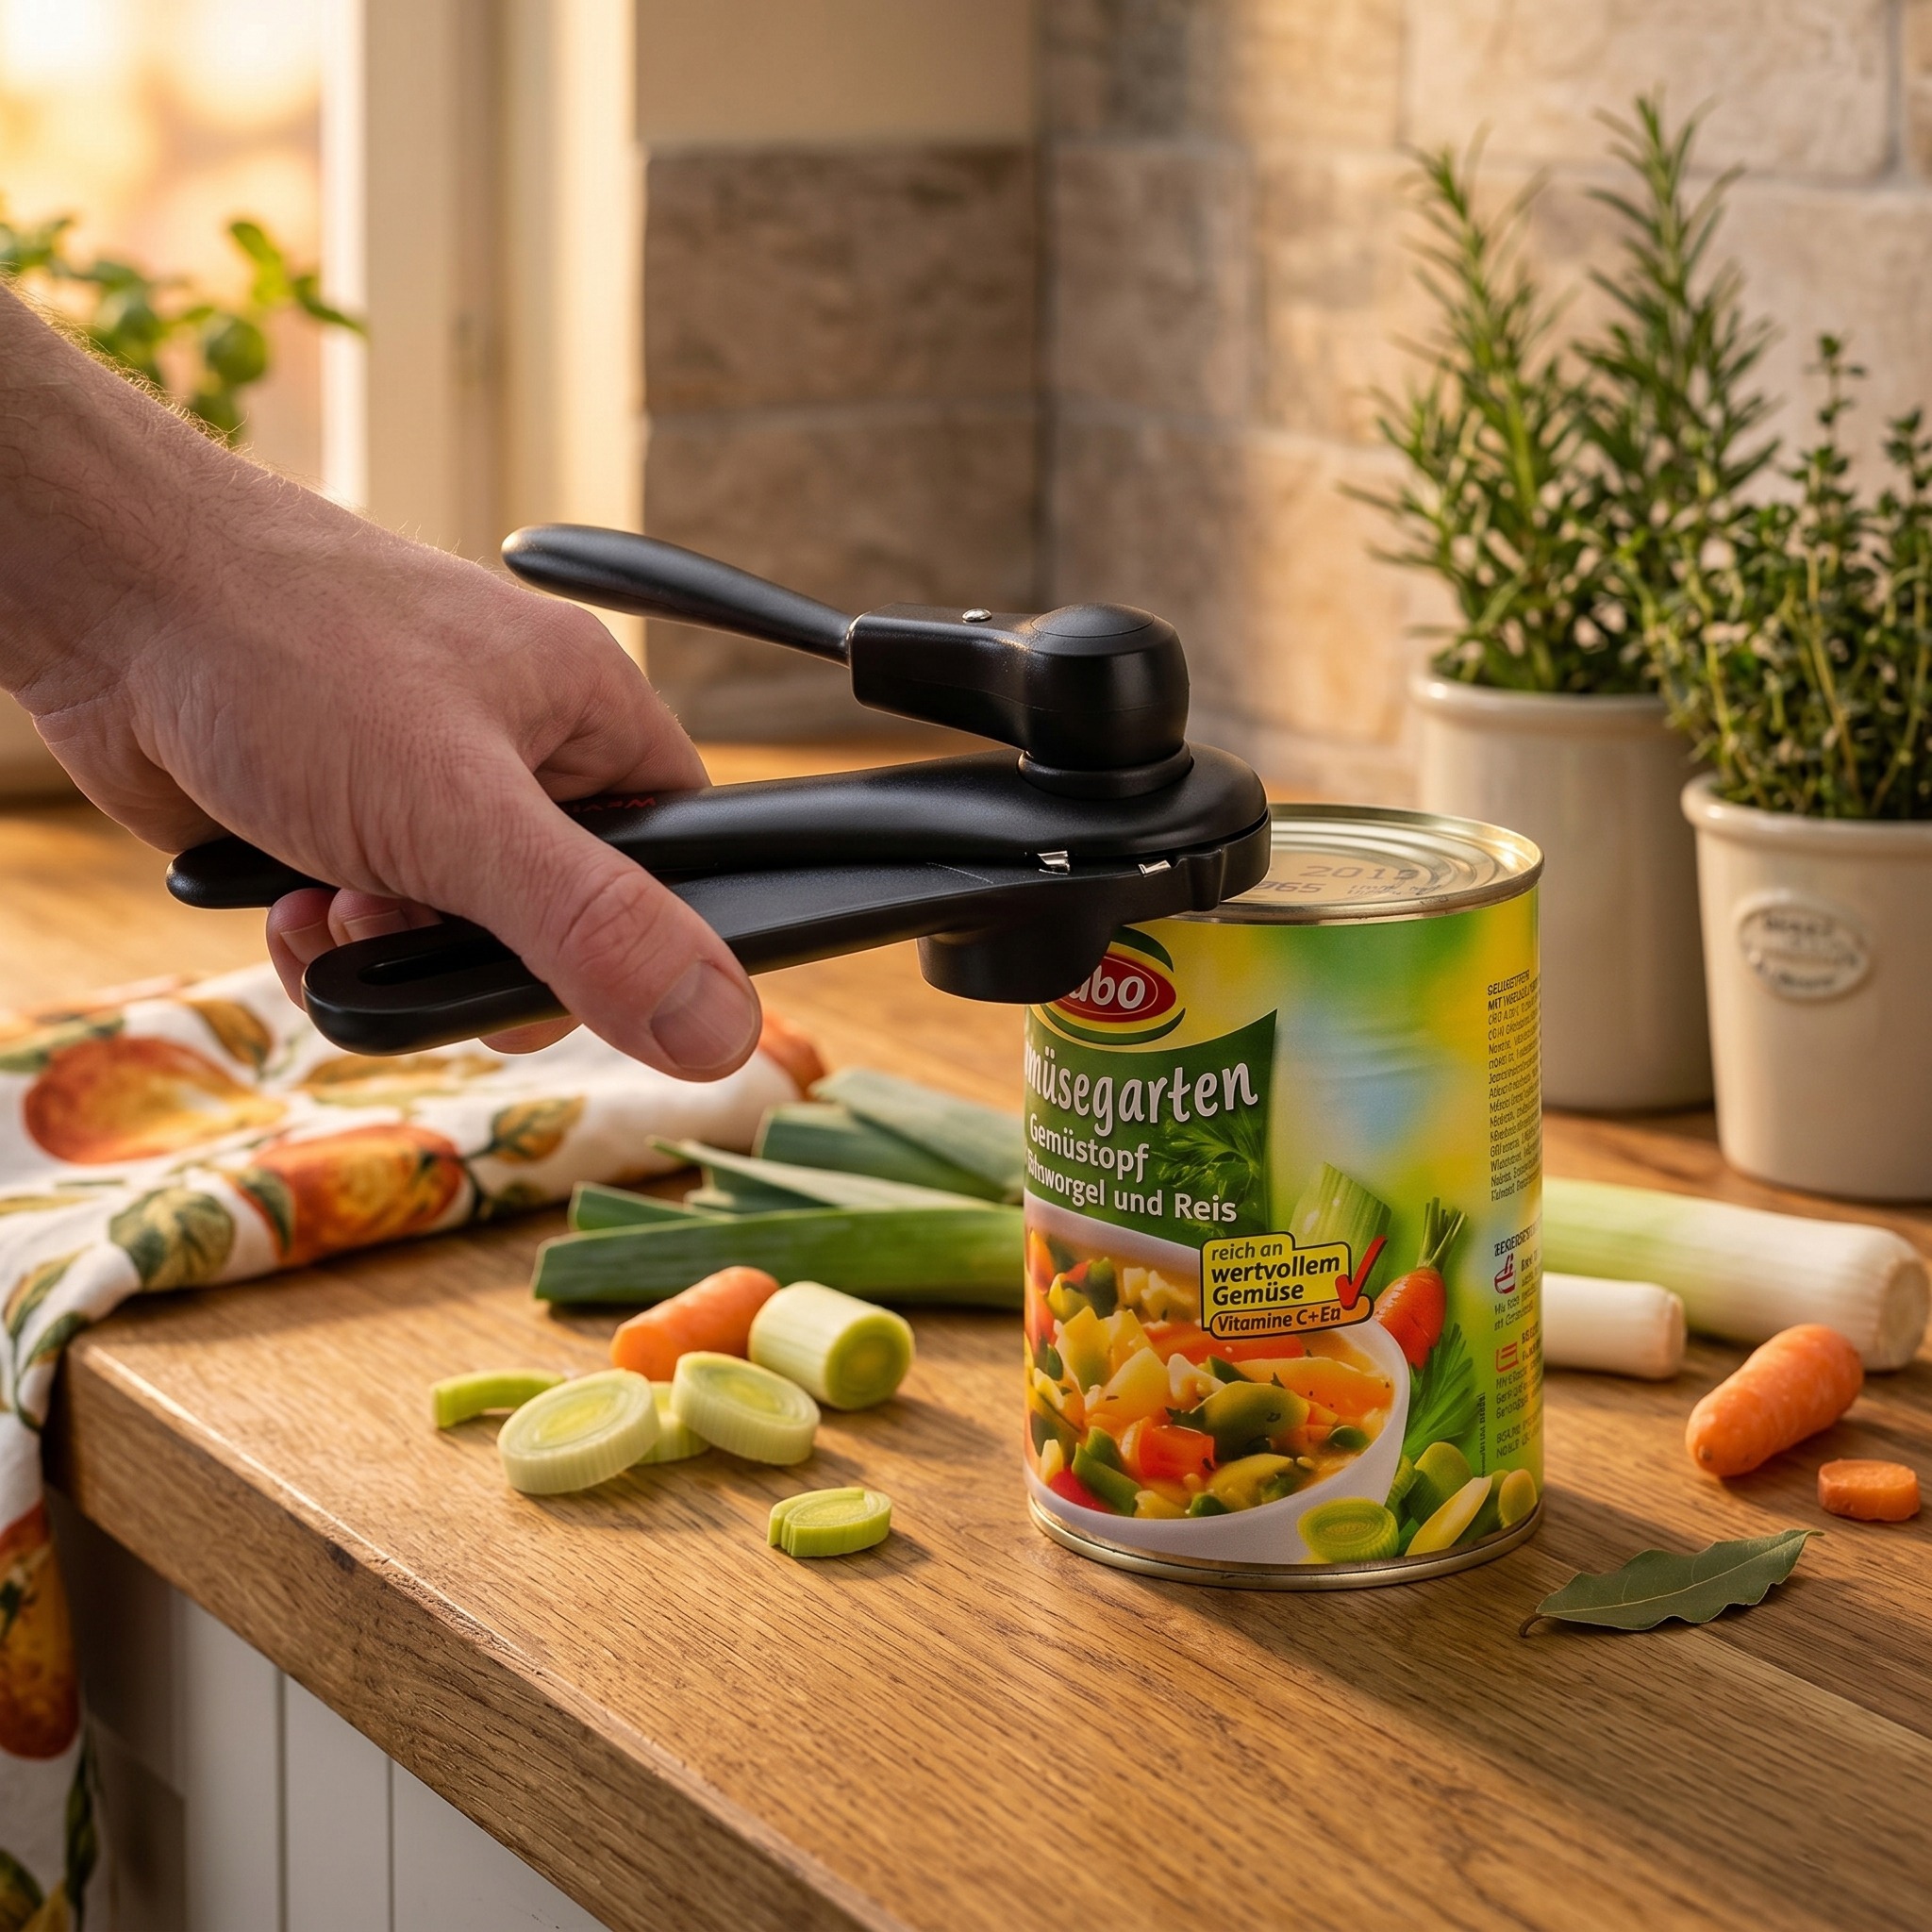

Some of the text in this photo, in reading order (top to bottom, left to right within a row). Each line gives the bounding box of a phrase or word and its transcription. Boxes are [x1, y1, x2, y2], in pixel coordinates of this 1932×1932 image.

[1030, 1112, 1150, 1183] Gemüstopf
[1114, 1190, 1163, 1216] und
[1174, 1193, 1238, 1223] Reis
[1211, 1241, 1283, 1261] reich an
[1211, 1255, 1341, 1283] wertvollem
[1212, 1281, 1305, 1306] Gemüse
[1218, 1312, 1292, 1332] Vitamine
